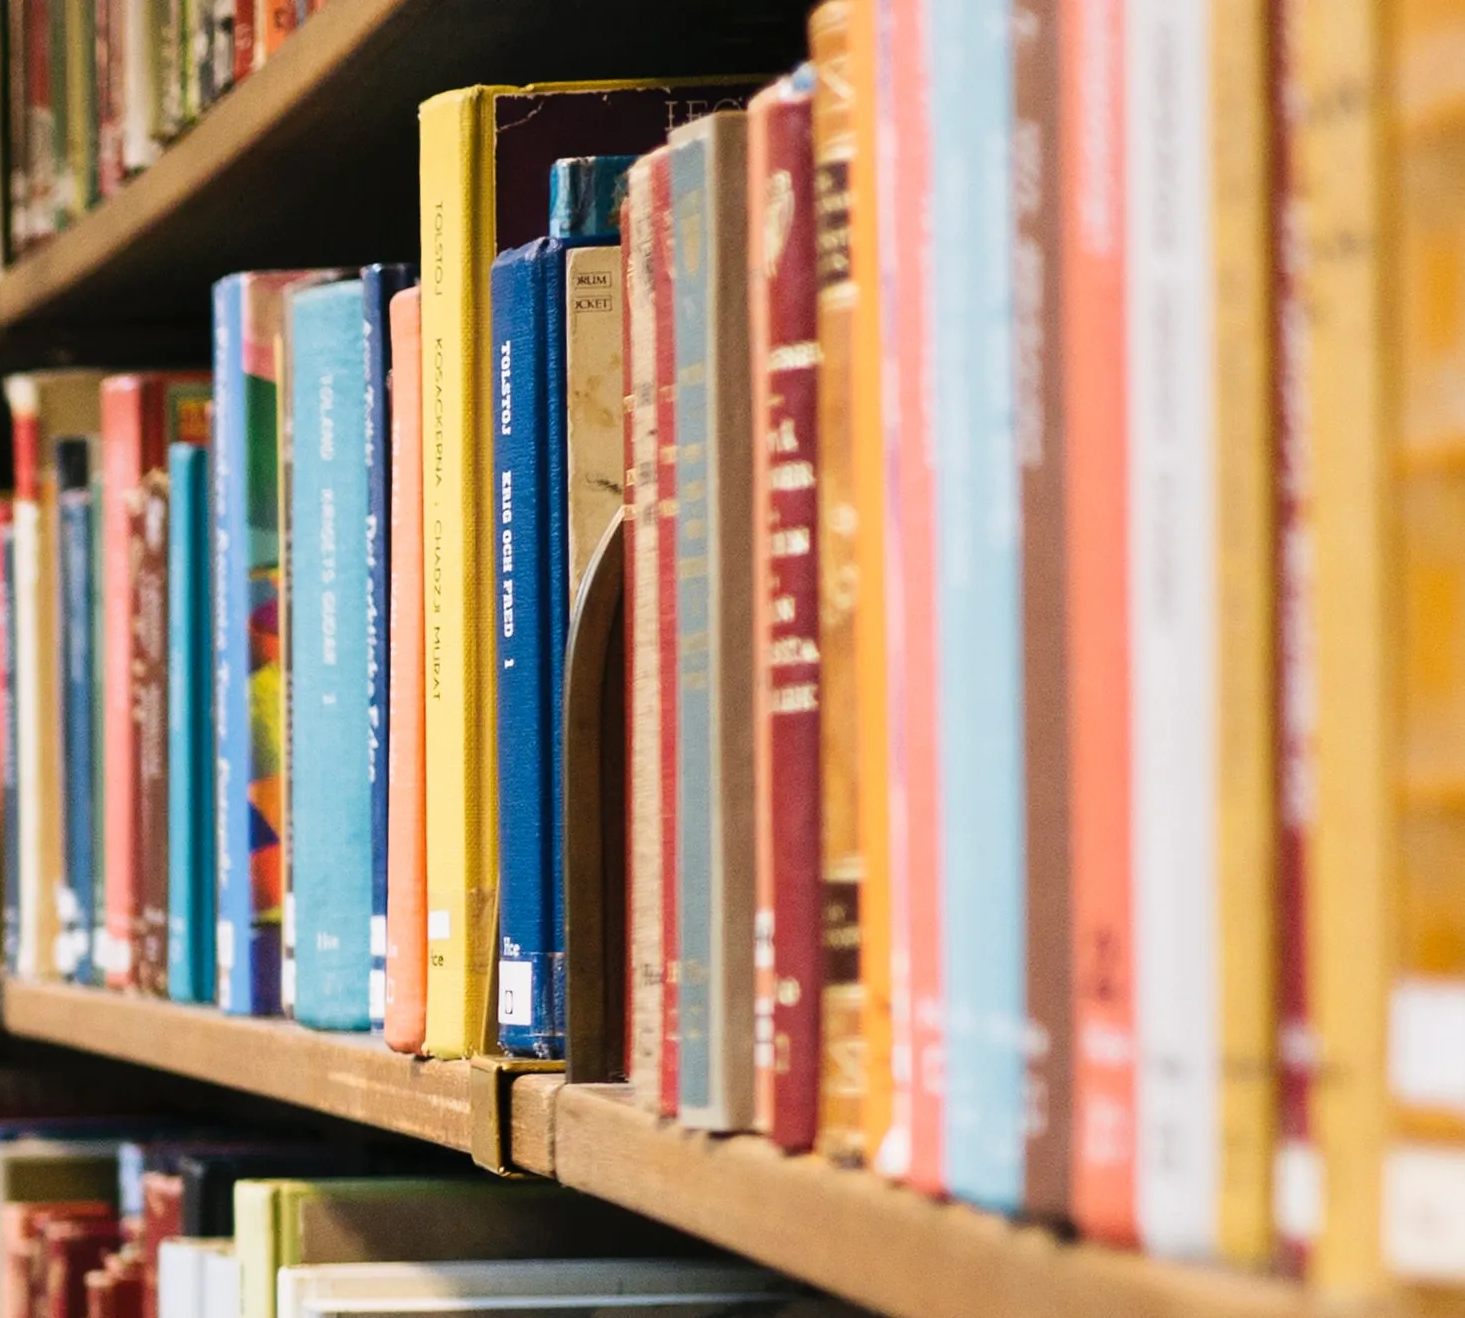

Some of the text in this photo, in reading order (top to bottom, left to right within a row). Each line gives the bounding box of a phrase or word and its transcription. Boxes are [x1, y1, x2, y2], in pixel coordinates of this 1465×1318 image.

[434, 201, 444, 296] TOLSTOJ
[433, 337, 444, 488] KOSACKERNA
[500, 339, 514, 669] TOLSTOJ KRIG OCH FRED 1
[432, 626, 443, 702] MURAT
